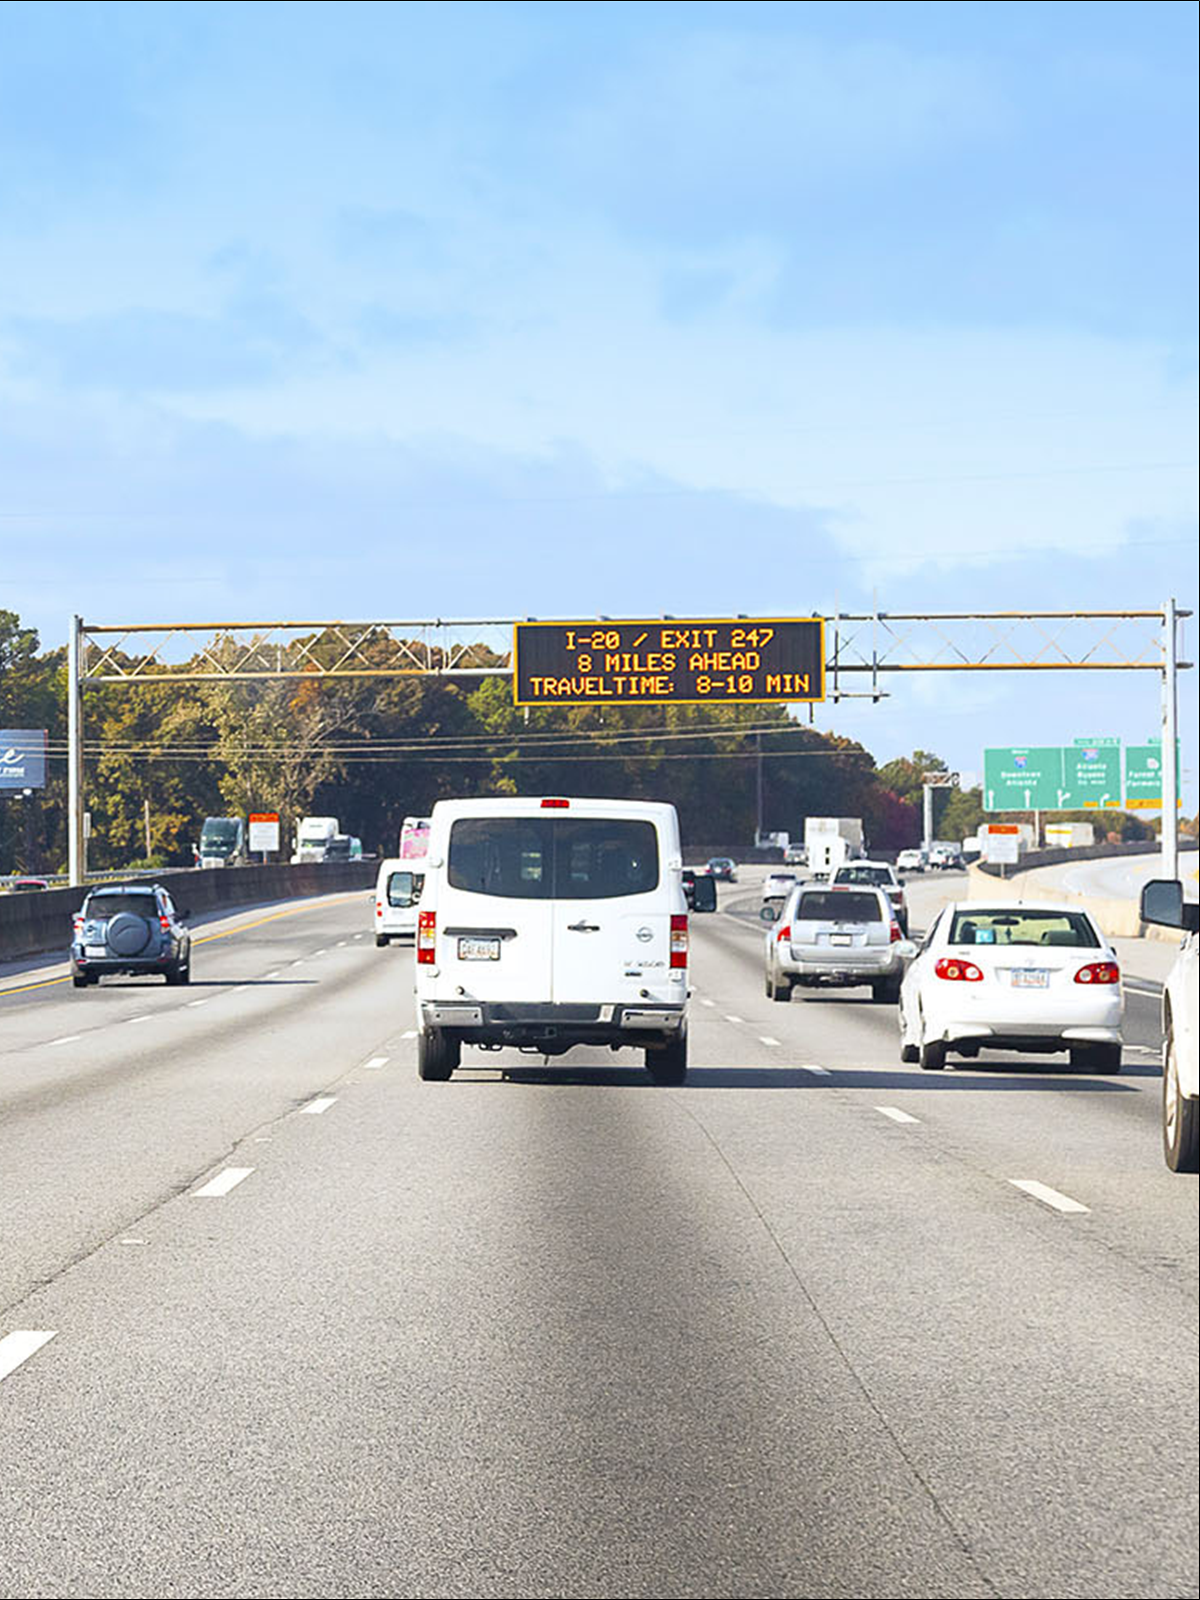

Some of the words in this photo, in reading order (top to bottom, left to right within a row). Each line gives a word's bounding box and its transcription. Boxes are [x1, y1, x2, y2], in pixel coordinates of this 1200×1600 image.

[565, 630, 620, 650] I-20
[632, 632, 648, 647] /
[660, 629, 718, 649] EXIT
[730, 628, 774, 648] 247
[577, 653, 592, 673] 8
[604, 652, 676, 673] MILES
[688, 651, 760, 671] AHEAD
[529, 675, 675, 696] TRAVELTIME:
[695, 674, 753, 694] 8-10
[766, 673, 810, 693] MIN
